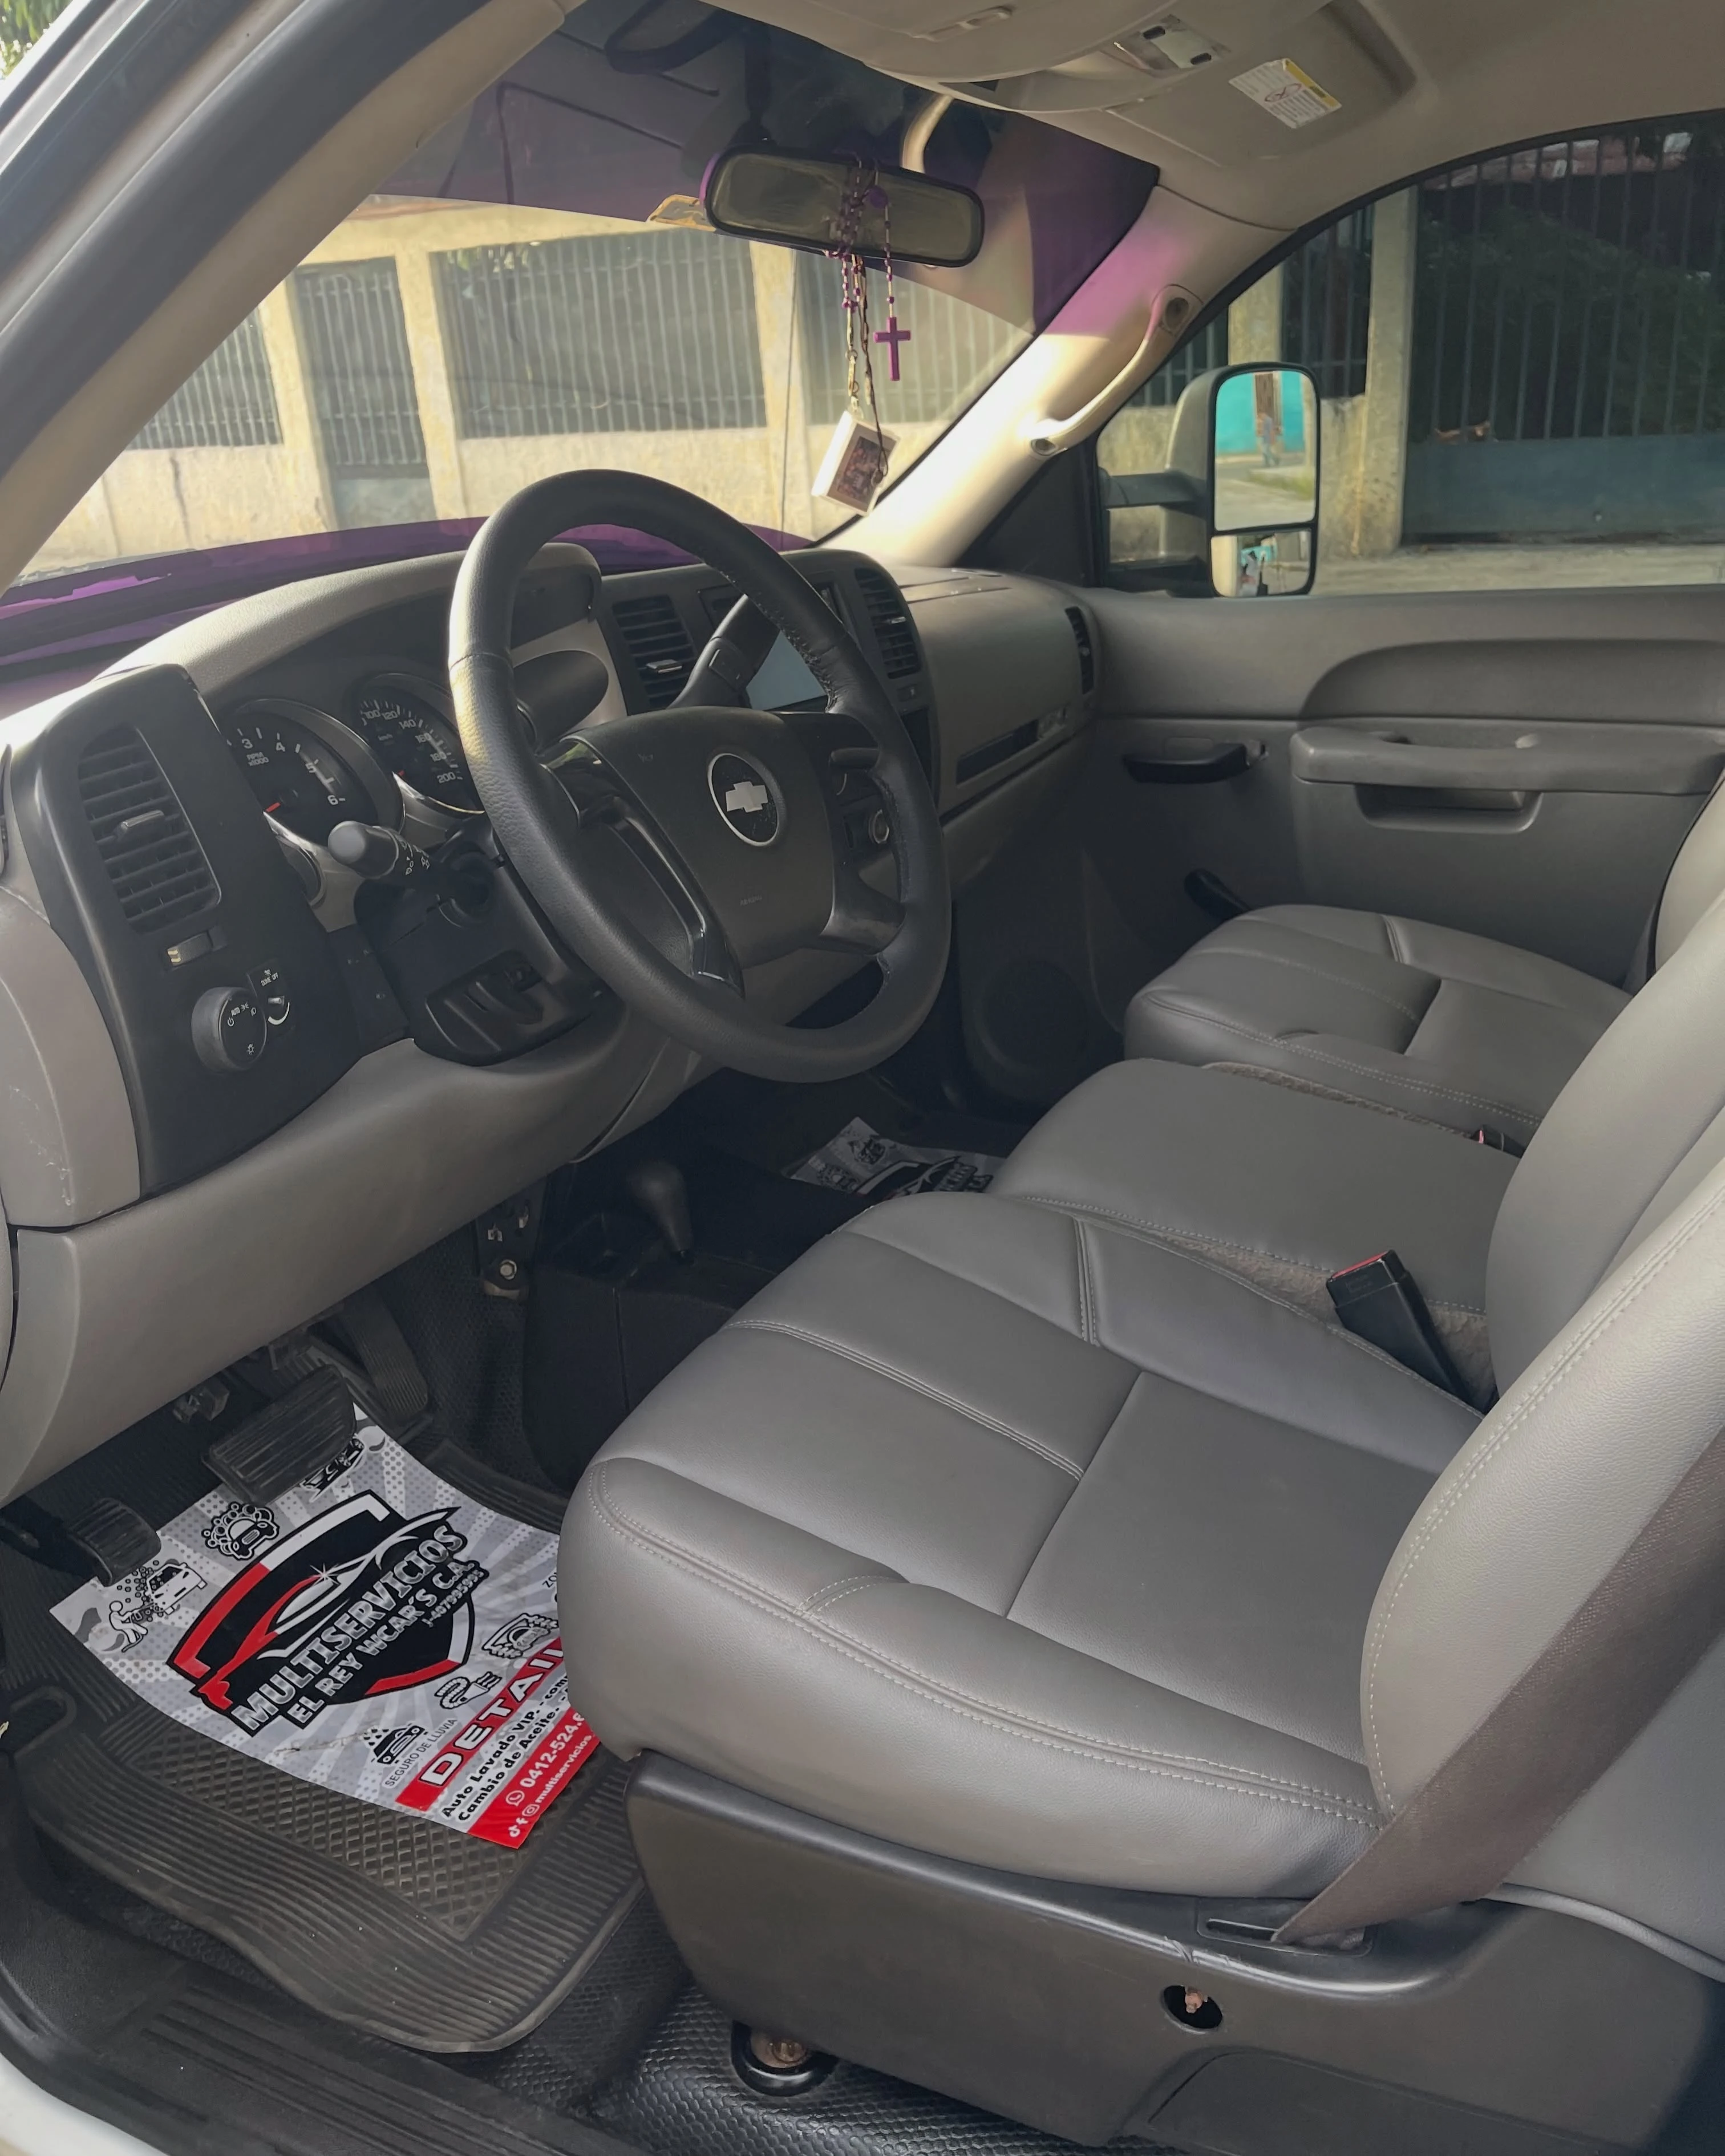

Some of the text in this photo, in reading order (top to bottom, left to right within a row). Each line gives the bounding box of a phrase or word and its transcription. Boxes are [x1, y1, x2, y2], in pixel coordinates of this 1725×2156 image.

[381, 711, 398, 720] 120
[399, 719, 416, 729] 140
[415, 732, 432, 743] 160
[241, 739, 253, 749] 3
[276, 742, 286, 752] 4
[430, 752, 447, 762] 180
[305, 762, 317, 773] 5
[437, 771, 456, 784] 200
[327, 795, 338, 805] 6
[231, 1525, 463, 1731] MULTISERVICIOS
[287, 1696, 325, 1723] EL
[315, 1653, 363, 1696] REY
[432, 1562, 475, 1589] C.A.
[442, 1786, 474, 1818] Auto
[469, 1734, 517, 1782] Lavado
[512, 1709, 540, 1732] VIP.
[545, 1675, 568, 1699] com
[385, 1718, 457, 1787] SEGURO DE LLUVIA
[458, 1772, 505, 1821] Cambio
[505, 1750, 521, 1769] de
[520, 1707, 560, 1749] Aceite.
